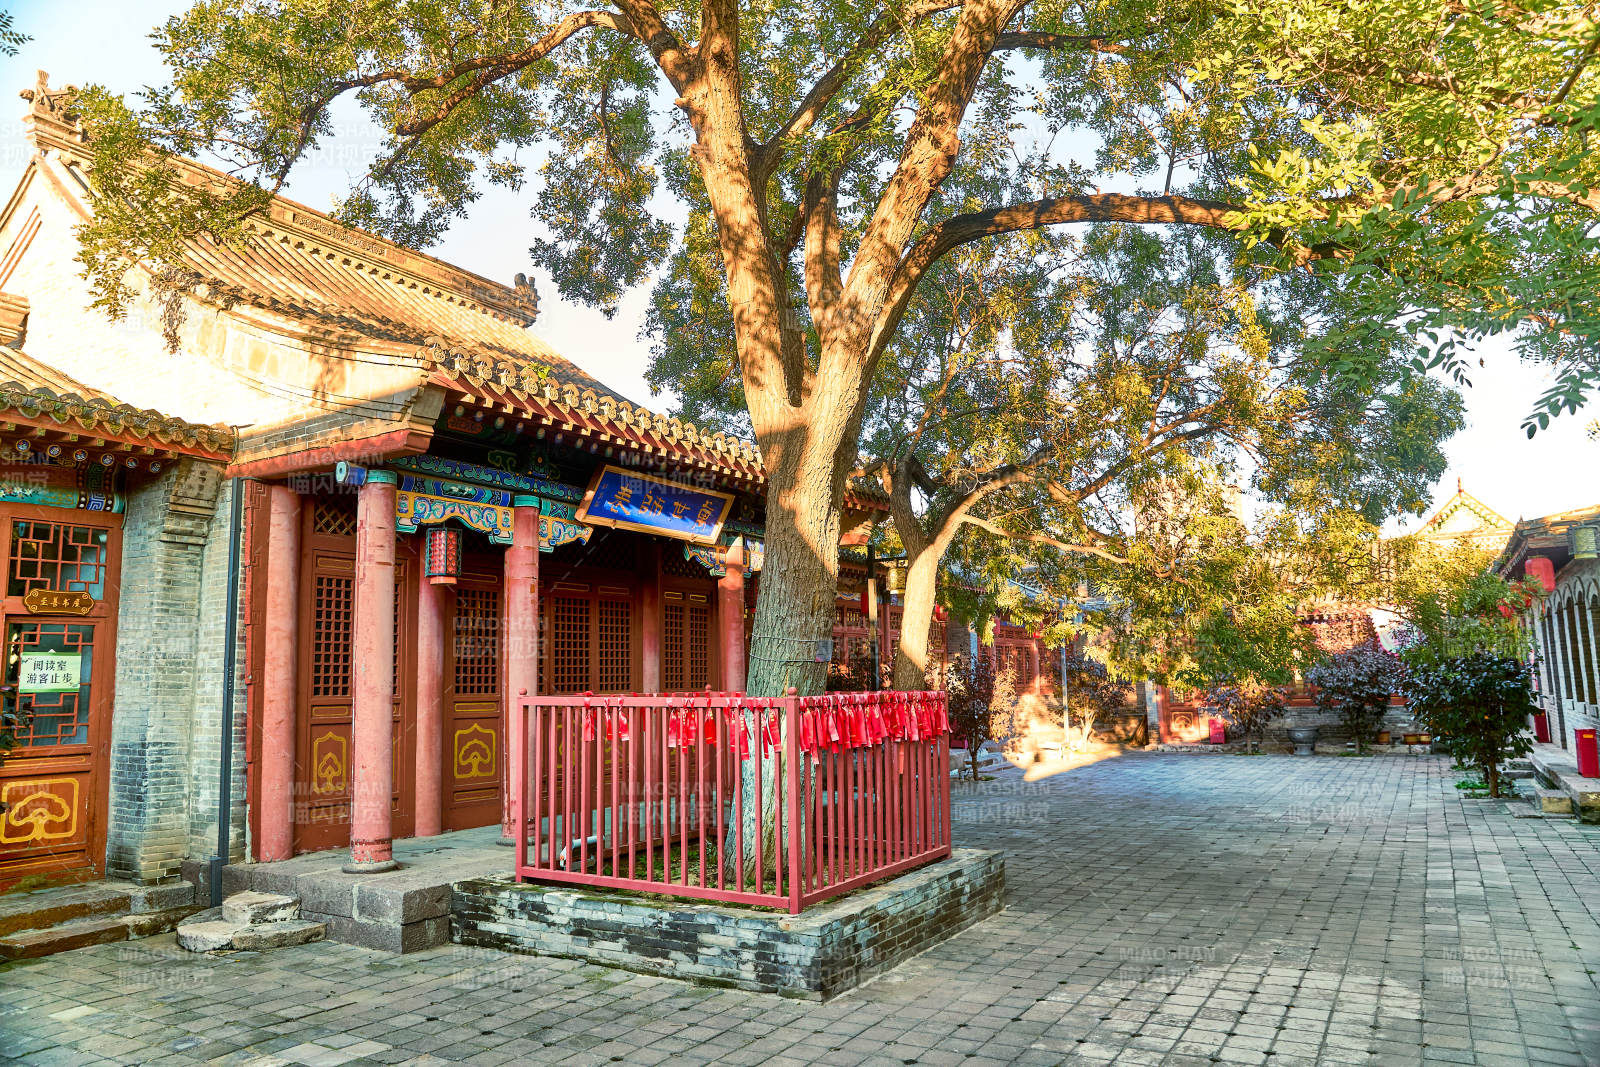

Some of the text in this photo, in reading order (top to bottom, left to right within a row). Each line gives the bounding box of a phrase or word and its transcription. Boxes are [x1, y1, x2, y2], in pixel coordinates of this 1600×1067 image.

[33, 660, 67, 671] 阅读室
[26, 673, 72, 684] 游客止步
